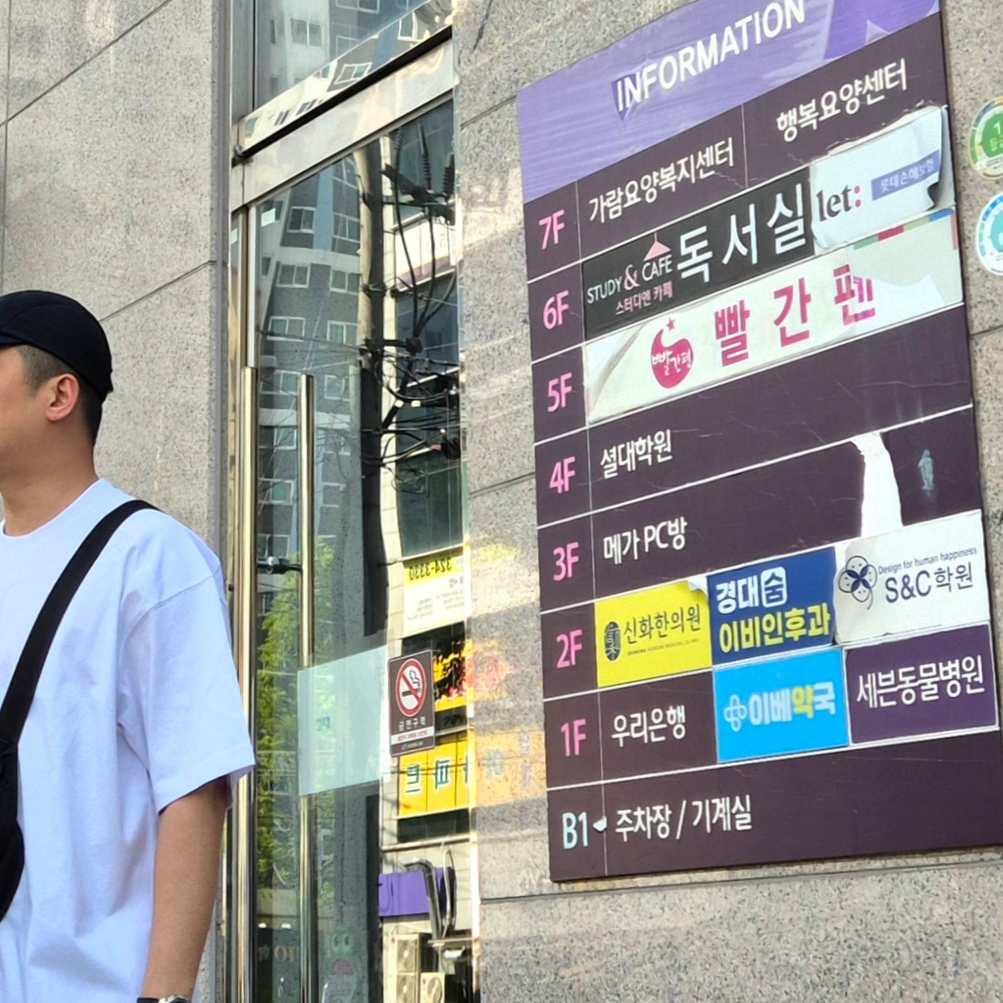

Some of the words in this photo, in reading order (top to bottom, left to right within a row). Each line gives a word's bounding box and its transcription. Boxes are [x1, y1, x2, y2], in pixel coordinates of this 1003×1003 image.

[617, 0, 805, 112] INFORMATION
[776, 58, 907, 142] 행복요양센터
[588, 137, 734, 223] 가람요양복지센터
[880, 157, 934, 193] 롯데손해보험
[816, 185, 861, 222] let:
[539, 210, 565, 250] 7F
[677, 183, 807, 283] 독서실
[587, 276, 623, 304] STUDY
[624, 264, 641, 291] &
[642, 254, 673, 282] CAFE
[653, 281, 673, 302] 카페
[543, 290, 569, 329] 6F
[714, 263, 876, 367] 빨간펜
[651, 349, 693, 377] 빨간펜
[547, 373, 572, 412] 5F
[549, 456, 575, 494] 4F
[603, 528, 640, 565] 메가
[644, 516, 687, 554] PC방
[553, 542, 579, 581] 3F
[878, 563, 902, 575] Design
[914, 554, 939, 567] human
[940, 547, 978, 562] happiness
[624, 603, 701, 644] 신화한의원
[719, 602, 831, 653] 이비인후과
[556, 629, 582, 668] 2F
[857, 655, 985, 708] 세븐동물병원
[749, 681, 836, 725] 이베약국
[561, 719, 586, 757] 1F
[611, 705, 686, 747] 우리은행
[562, 811, 588, 849] B1
[615, 803, 672, 842] 주차장
[692, 794, 752, 833] 기계실
